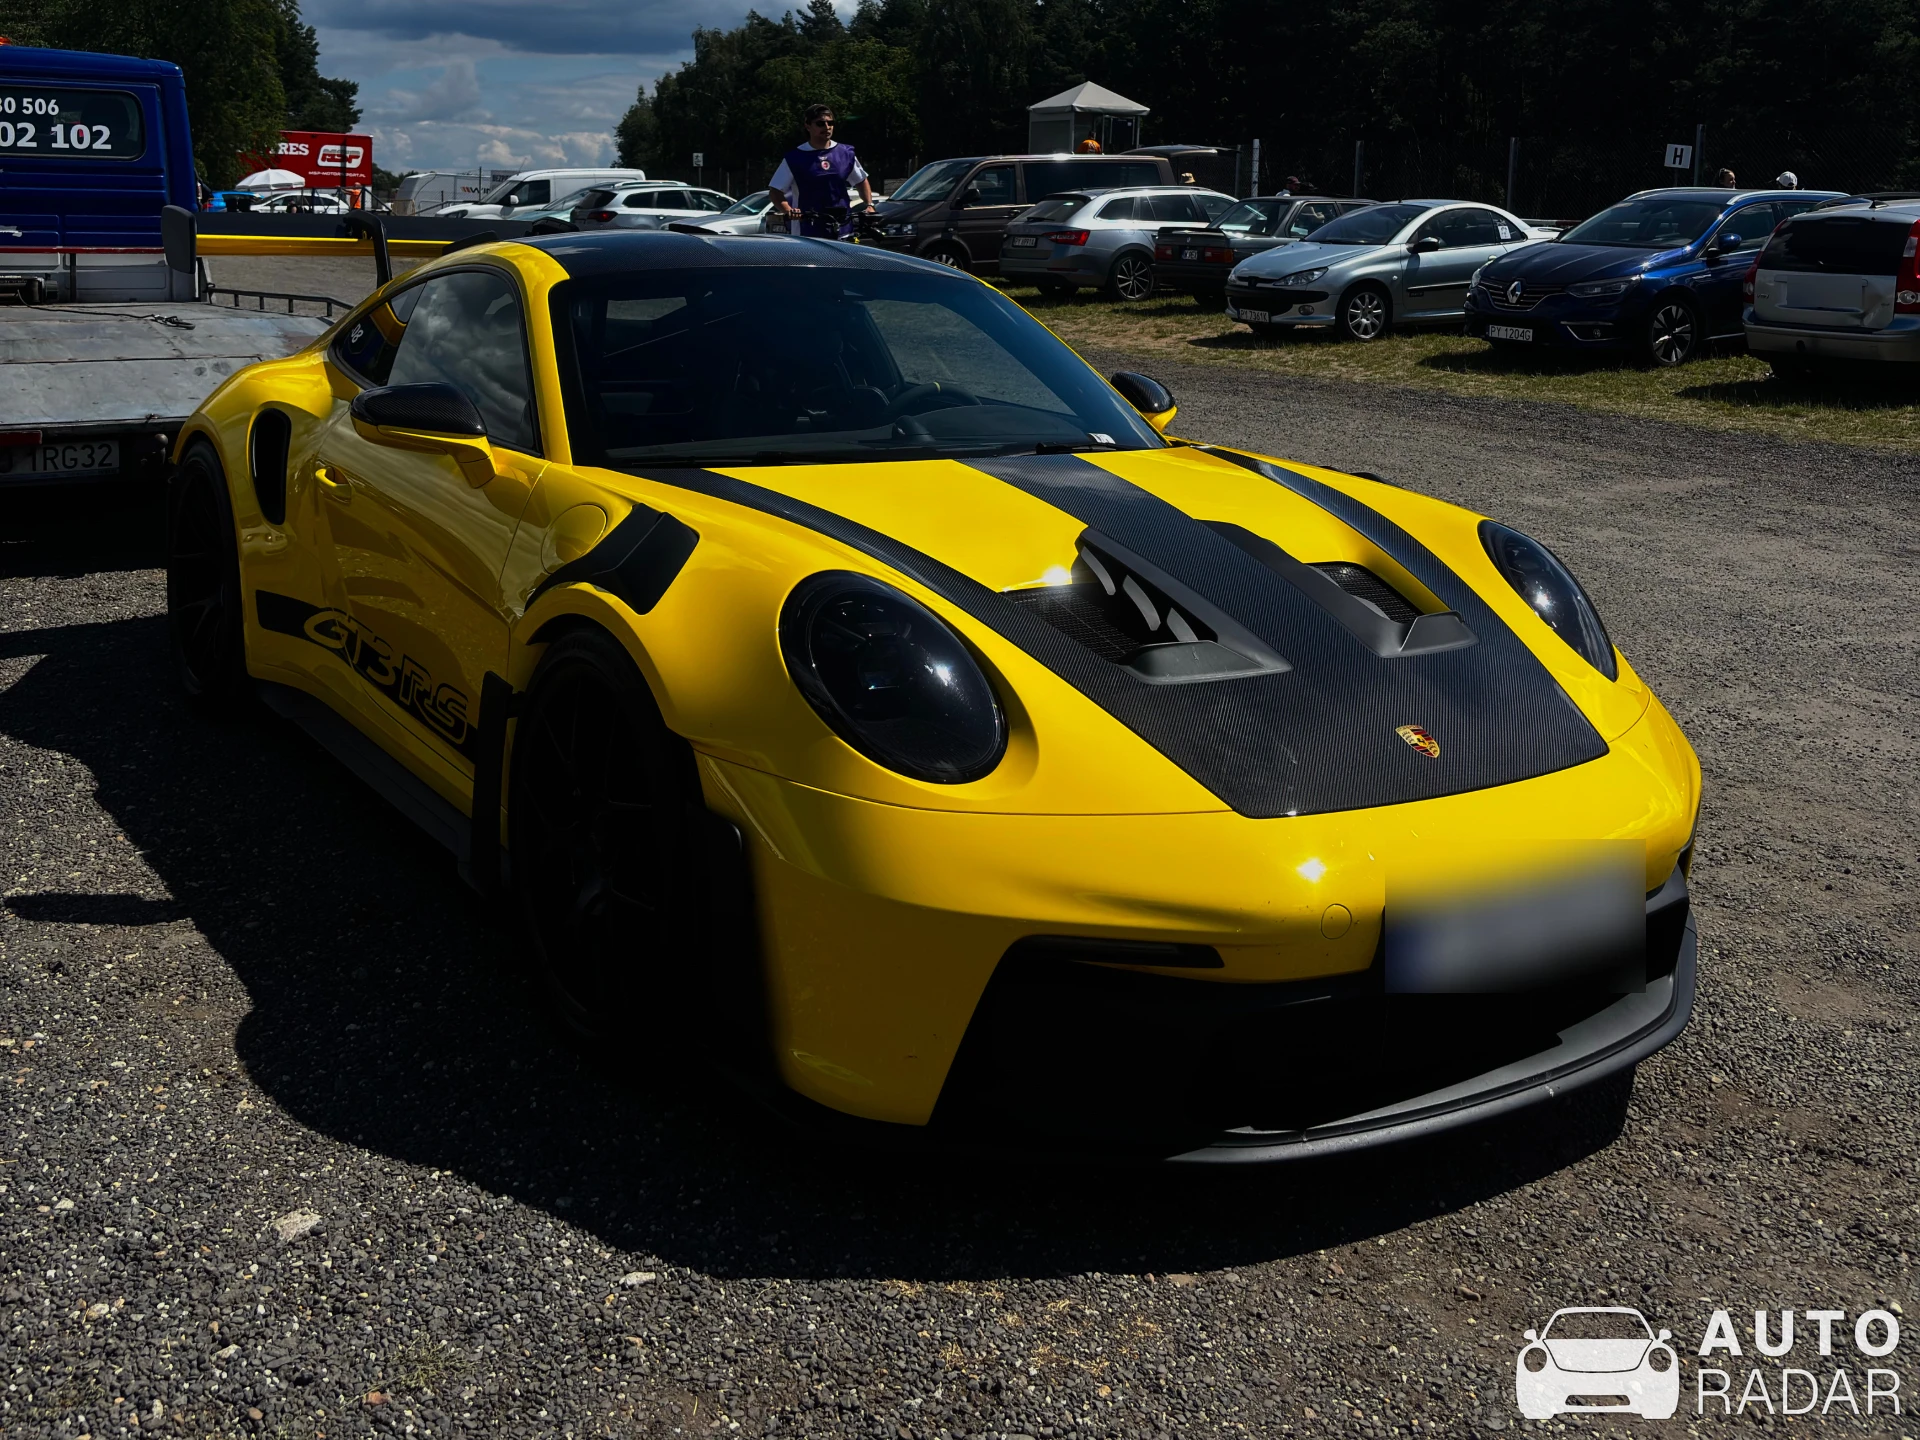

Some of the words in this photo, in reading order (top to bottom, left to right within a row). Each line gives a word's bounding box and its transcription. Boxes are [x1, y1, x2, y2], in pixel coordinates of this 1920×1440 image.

[0, 96, 17, 114] 0
[21, 97, 60, 116] 506
[50, 123, 112, 150] 102
[1672, 147, 1684, 165] H
[1490, 325, 1502, 338] PY
[1504, 327, 1531, 341] 1204G
